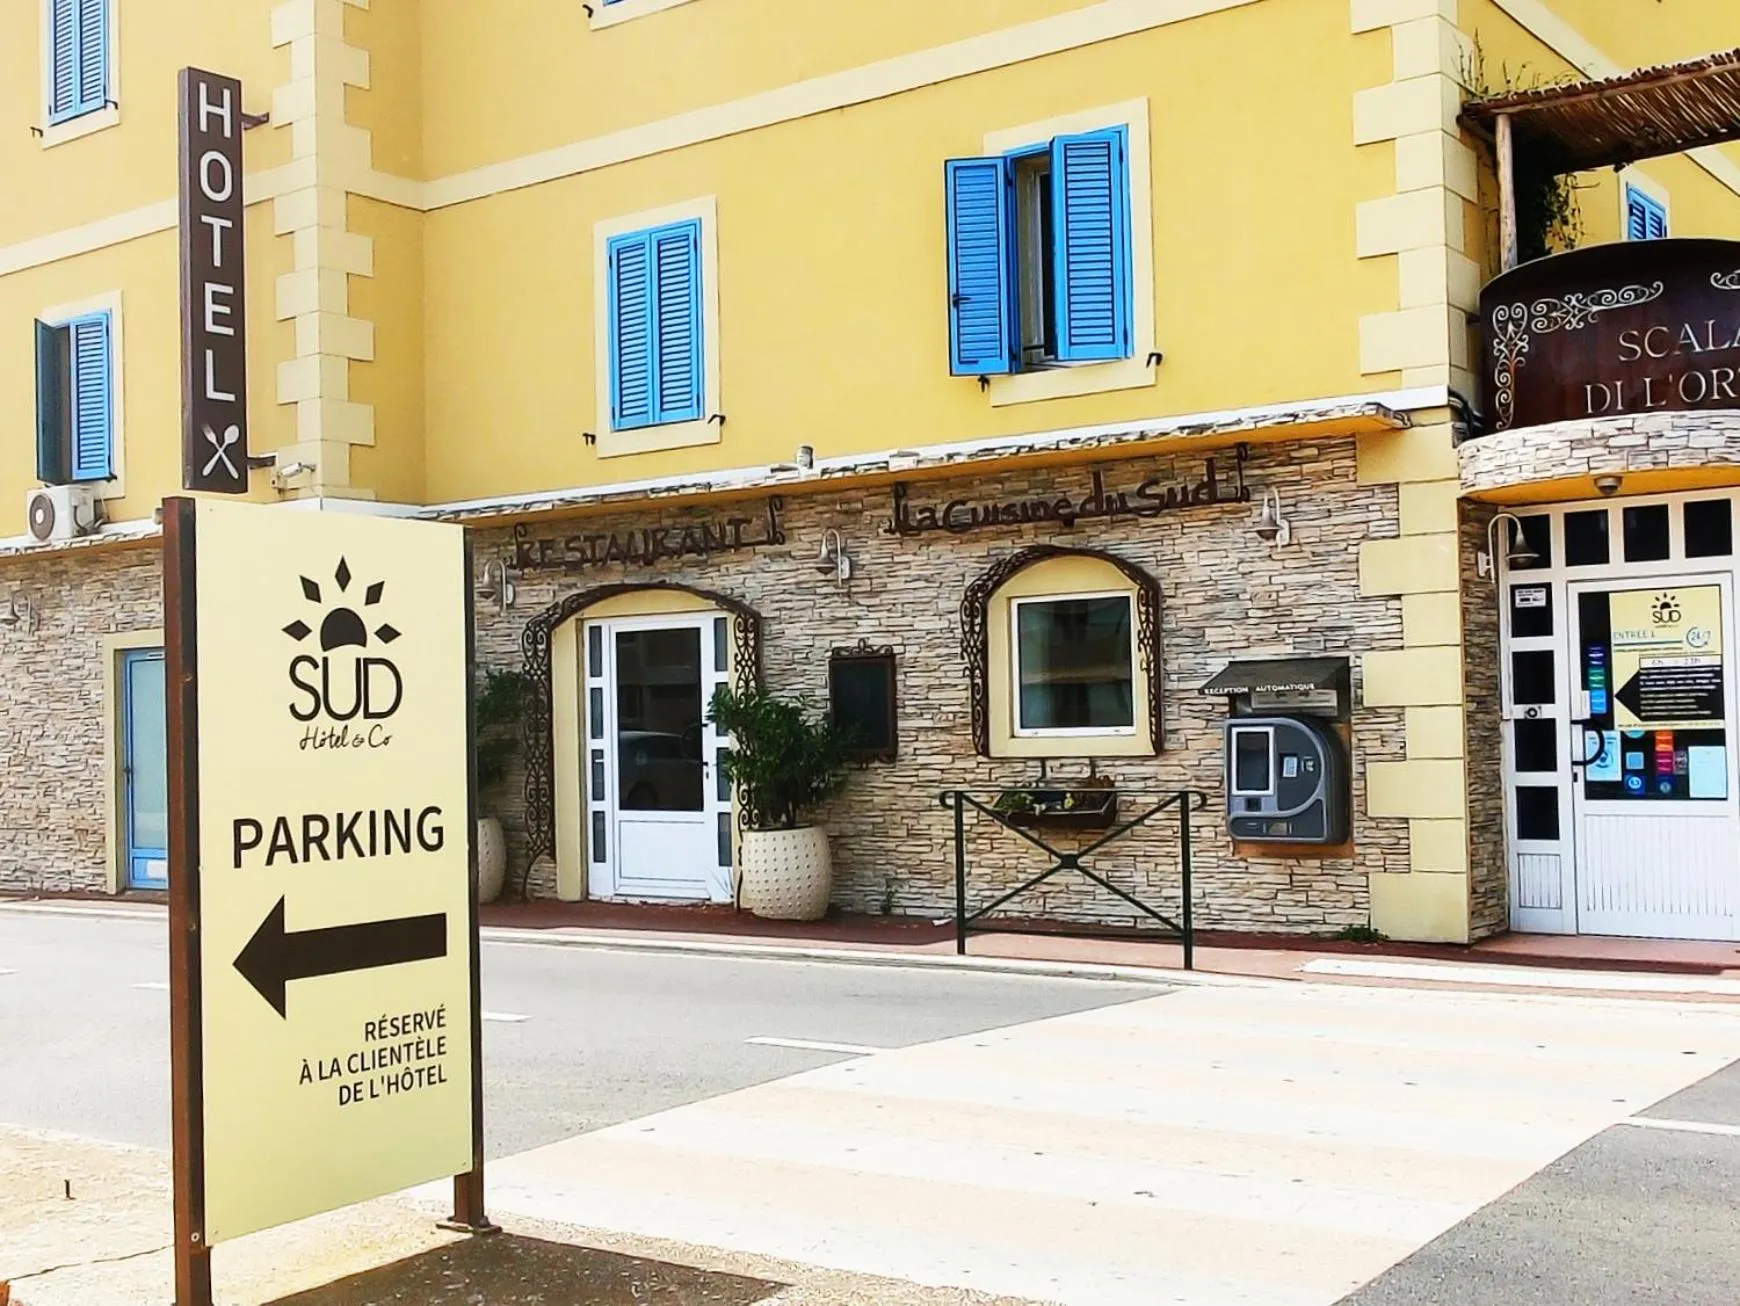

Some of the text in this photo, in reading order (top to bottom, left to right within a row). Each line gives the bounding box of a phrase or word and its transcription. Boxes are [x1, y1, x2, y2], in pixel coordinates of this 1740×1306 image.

[198, 82, 236, 402] HOTEL
[1584, 367, 1740, 414] DI L'OR
[942, 497, 1075, 533] Cuisine
[1080, 464, 1131, 517] du
[1131, 457, 1219, 517] Sud
[514, 517, 752, 571] RESTAURANT
[1652, 609, 1682, 624] SUD
[288, 655, 403, 721] SUD
[1203, 682, 1315, 695] RECEPTION AUTOMATIQUE
[368, 723, 393, 748] Co
[233, 805, 444, 869] PARKING
[364, 1003, 447, 1043] RÉSERVÉ
[298, 1035, 448, 1085] À LA CLIENTÈLE
[338, 1063, 448, 1106] DE L'HÔTEL
